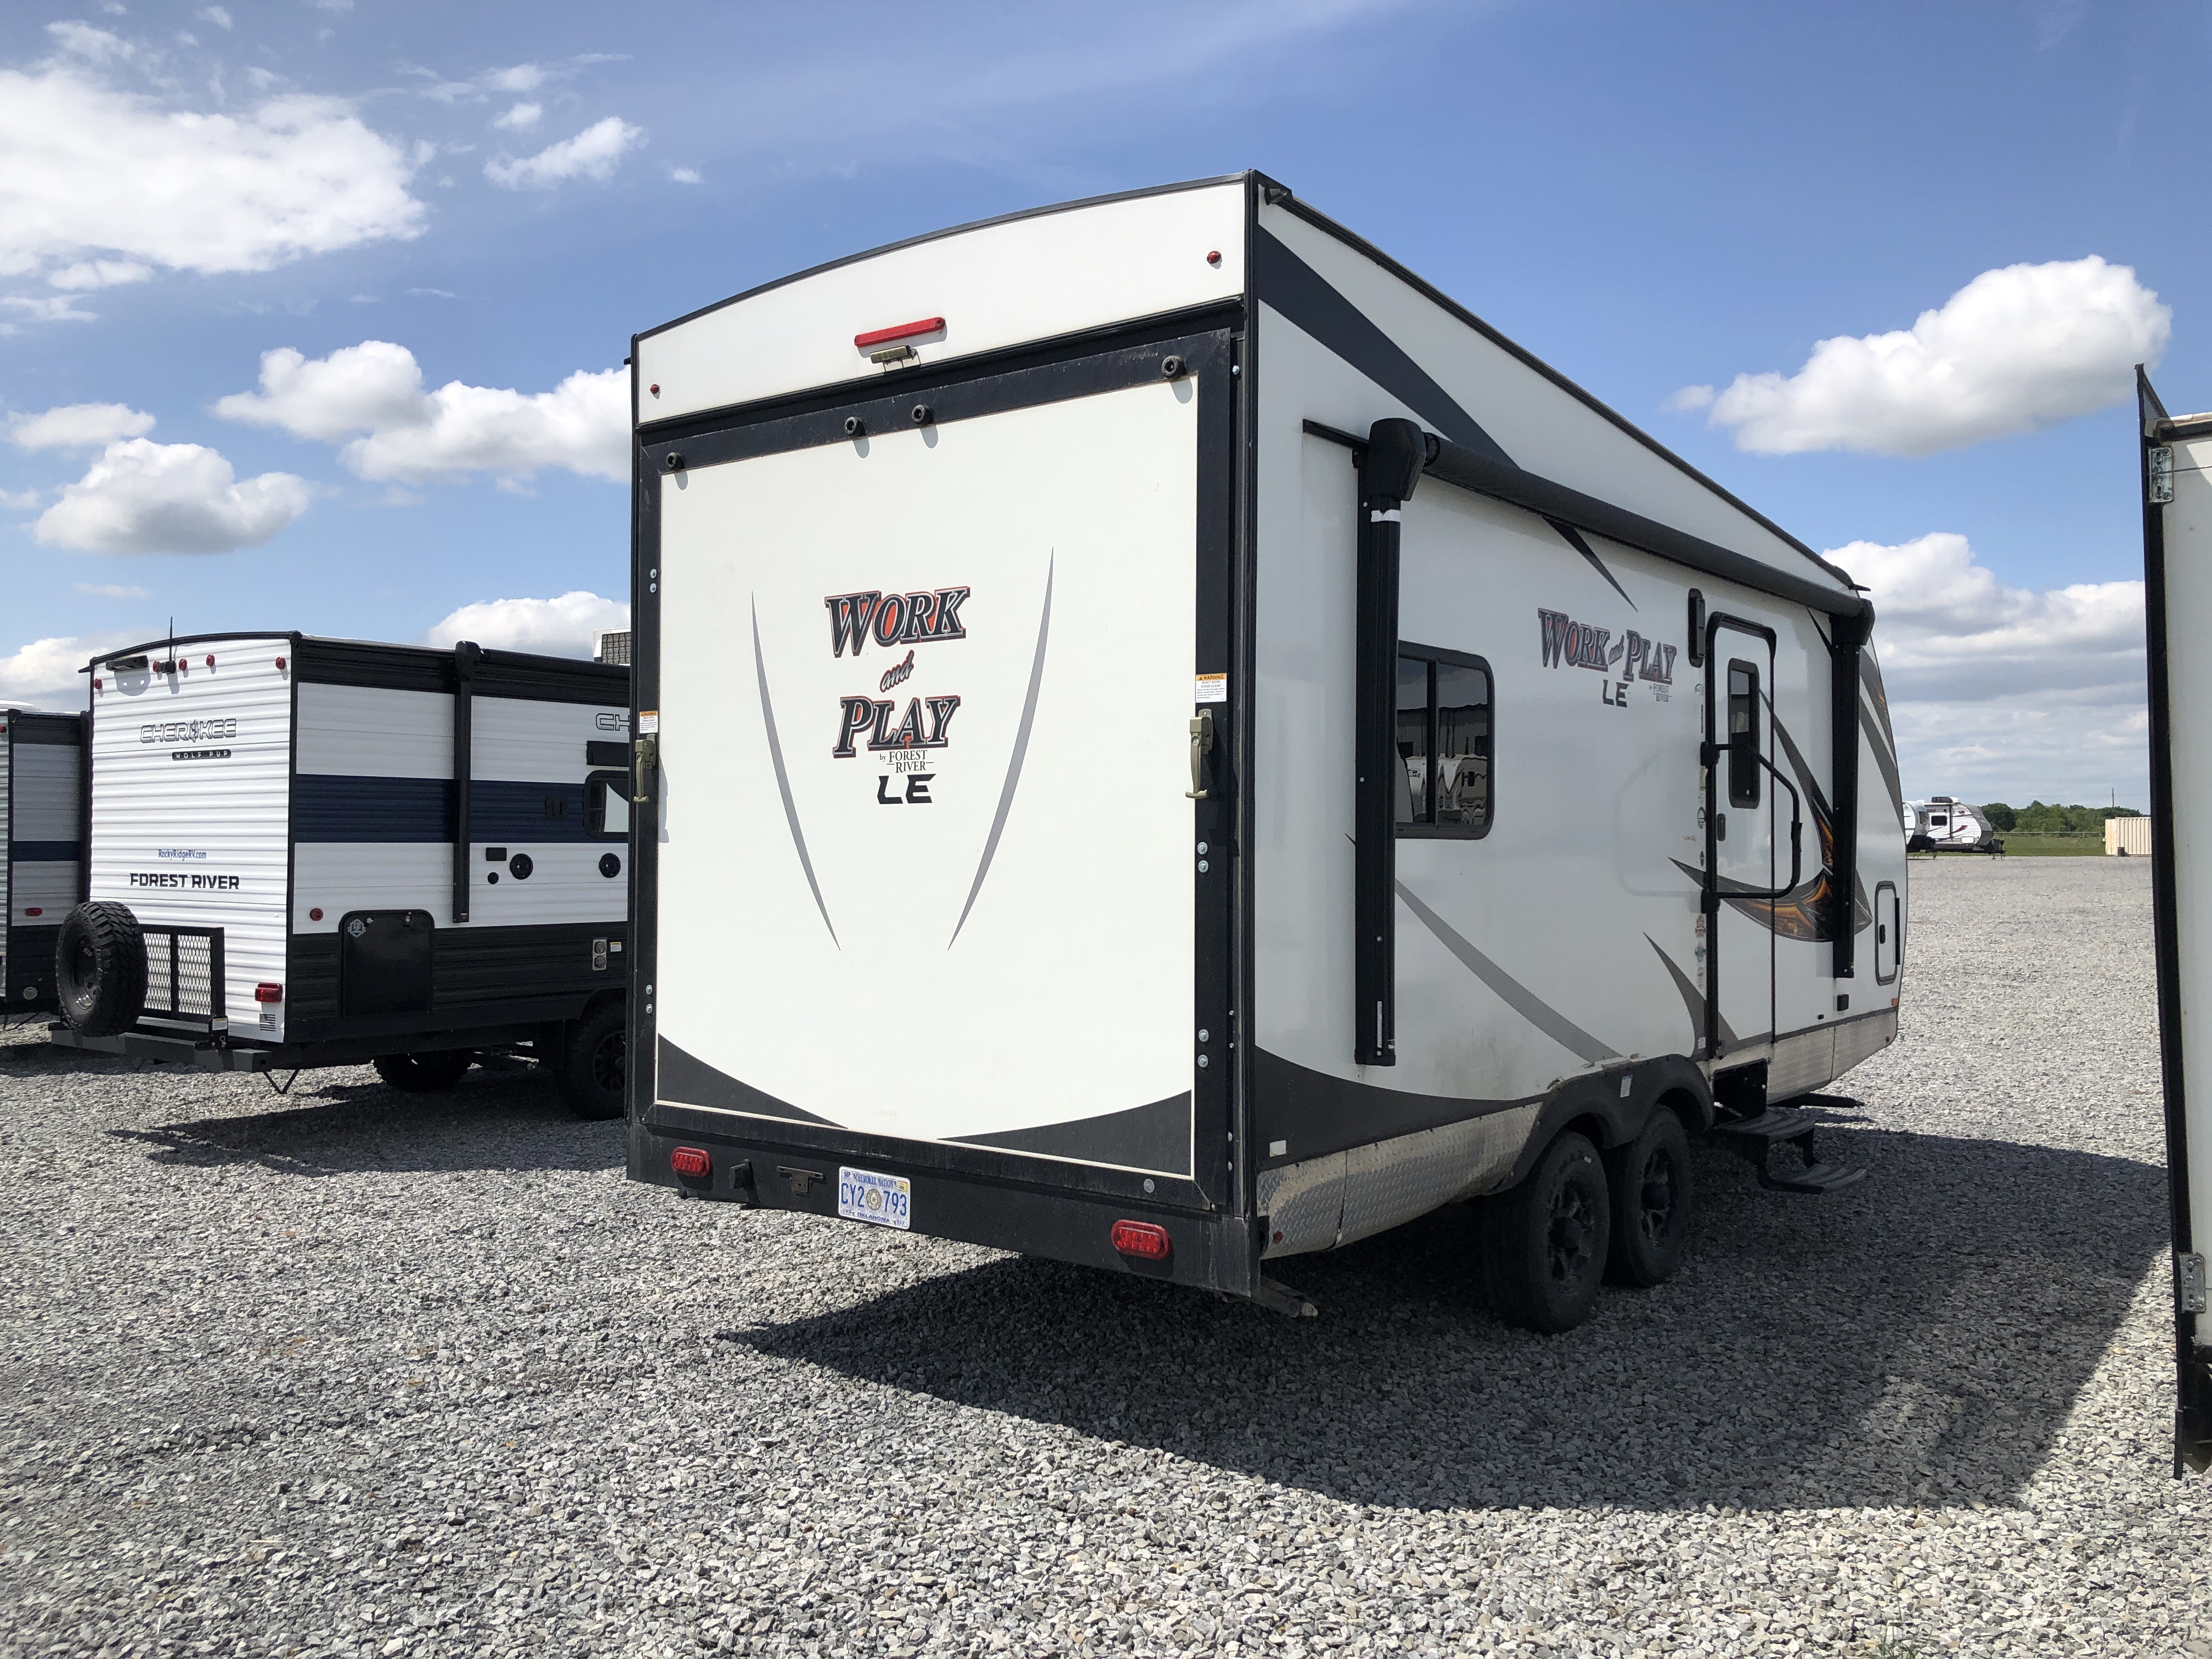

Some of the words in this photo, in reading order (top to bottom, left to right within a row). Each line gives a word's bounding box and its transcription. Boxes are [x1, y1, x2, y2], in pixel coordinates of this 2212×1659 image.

[825, 586, 970, 658] WORK
[1537, 607, 1610, 672] WORK
[1623, 629, 1677, 685] PLAY
[879, 650, 915, 692] and
[1602, 680, 1630, 708] LE
[832, 695, 961, 758] PLAY
[879, 753, 886, 762] by
[888, 749, 927, 763] FOREST
[895, 761, 927, 773] RIVER
[877, 774, 936, 804] LE
[158, 849, 207, 861] RockyRidgeRV.com
[129, 873, 188, 888] FOREST
[191, 874, 240, 889] RIVER
[855, 1173, 877, 1185] CHEROKEE
[878, 1178, 894, 1188] NATION
[841, 1182, 865, 1208] CY2
[883, 1190, 907, 1216] 793
[857, 1212, 890, 1222] OKLAHOMA
